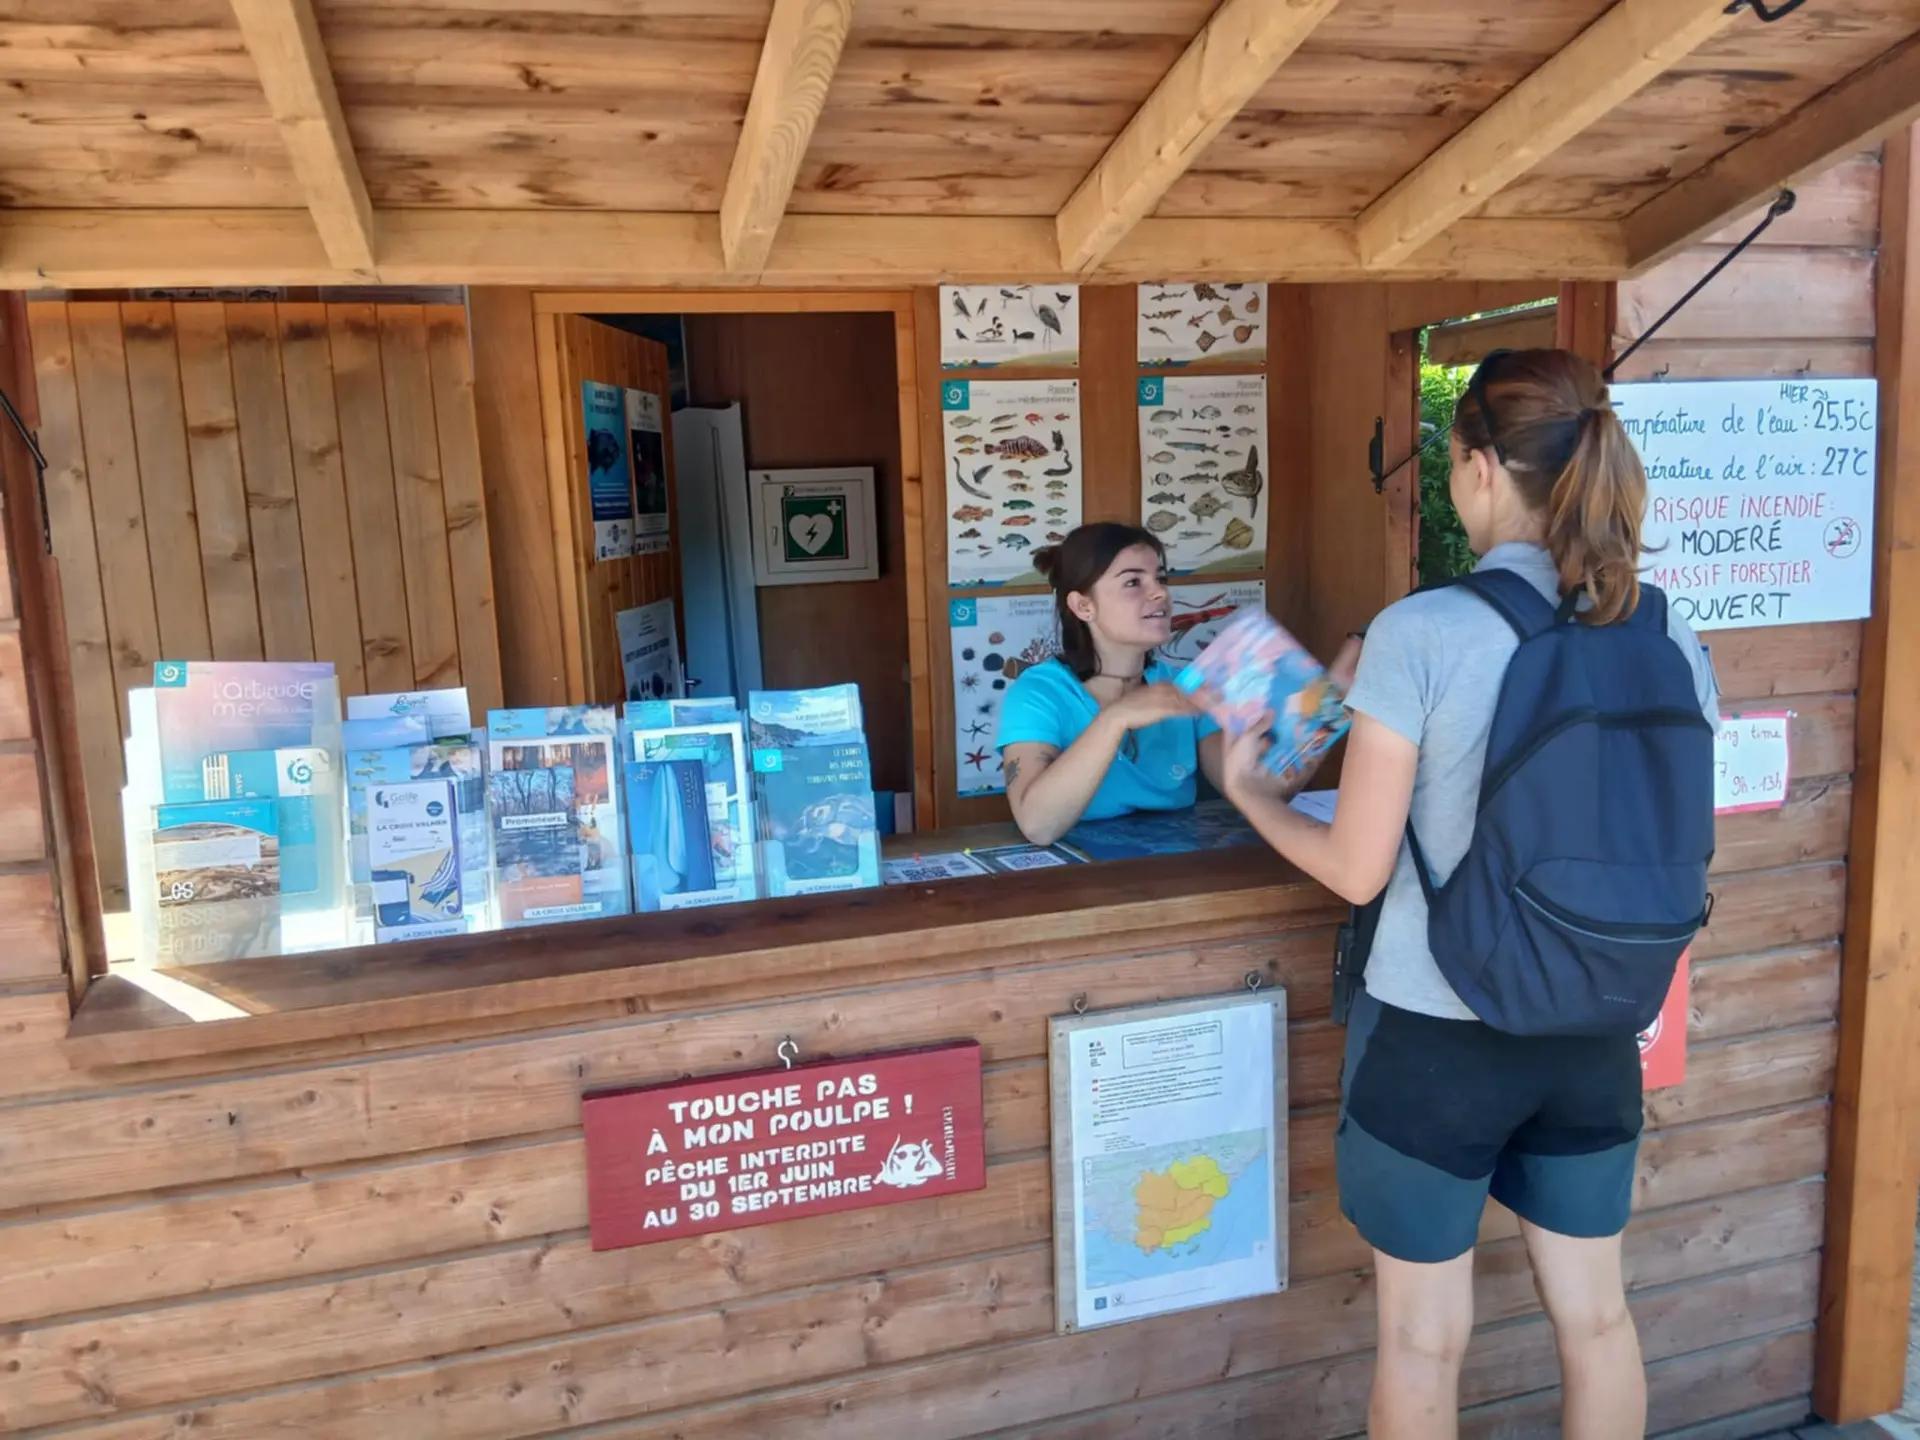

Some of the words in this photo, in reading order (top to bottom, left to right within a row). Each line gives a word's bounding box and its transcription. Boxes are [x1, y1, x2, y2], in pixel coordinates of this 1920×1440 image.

[1780, 382, 1809, 403] HIER
[1722, 403, 1745, 434] de
[1723, 455, 1746, 480] de
[1672, 592, 1791, 621] OUVERT
[212, 702, 265, 718] mer
[1751, 724, 1781, 739] time
[668, 1084, 802, 1124] TOUCHE
[817, 1074, 878, 1101] PAS
[647, 1128, 668, 1155] À
[683, 1118, 755, 1150] MON
[769, 1097, 890, 1136] POULPE
[645, 1156, 729, 1186] PÊCHE
[740, 1135, 866, 1170] INTERDITE
[680, 1179, 716, 1201] DU
[728, 1171, 769, 1193] 1ER
[780, 1160, 835, 1184] JUIN
[643, 1207, 678, 1229] AU
[689, 1200, 720, 1220] 30
[731, 1175, 873, 1214] SEPTEMBRE
